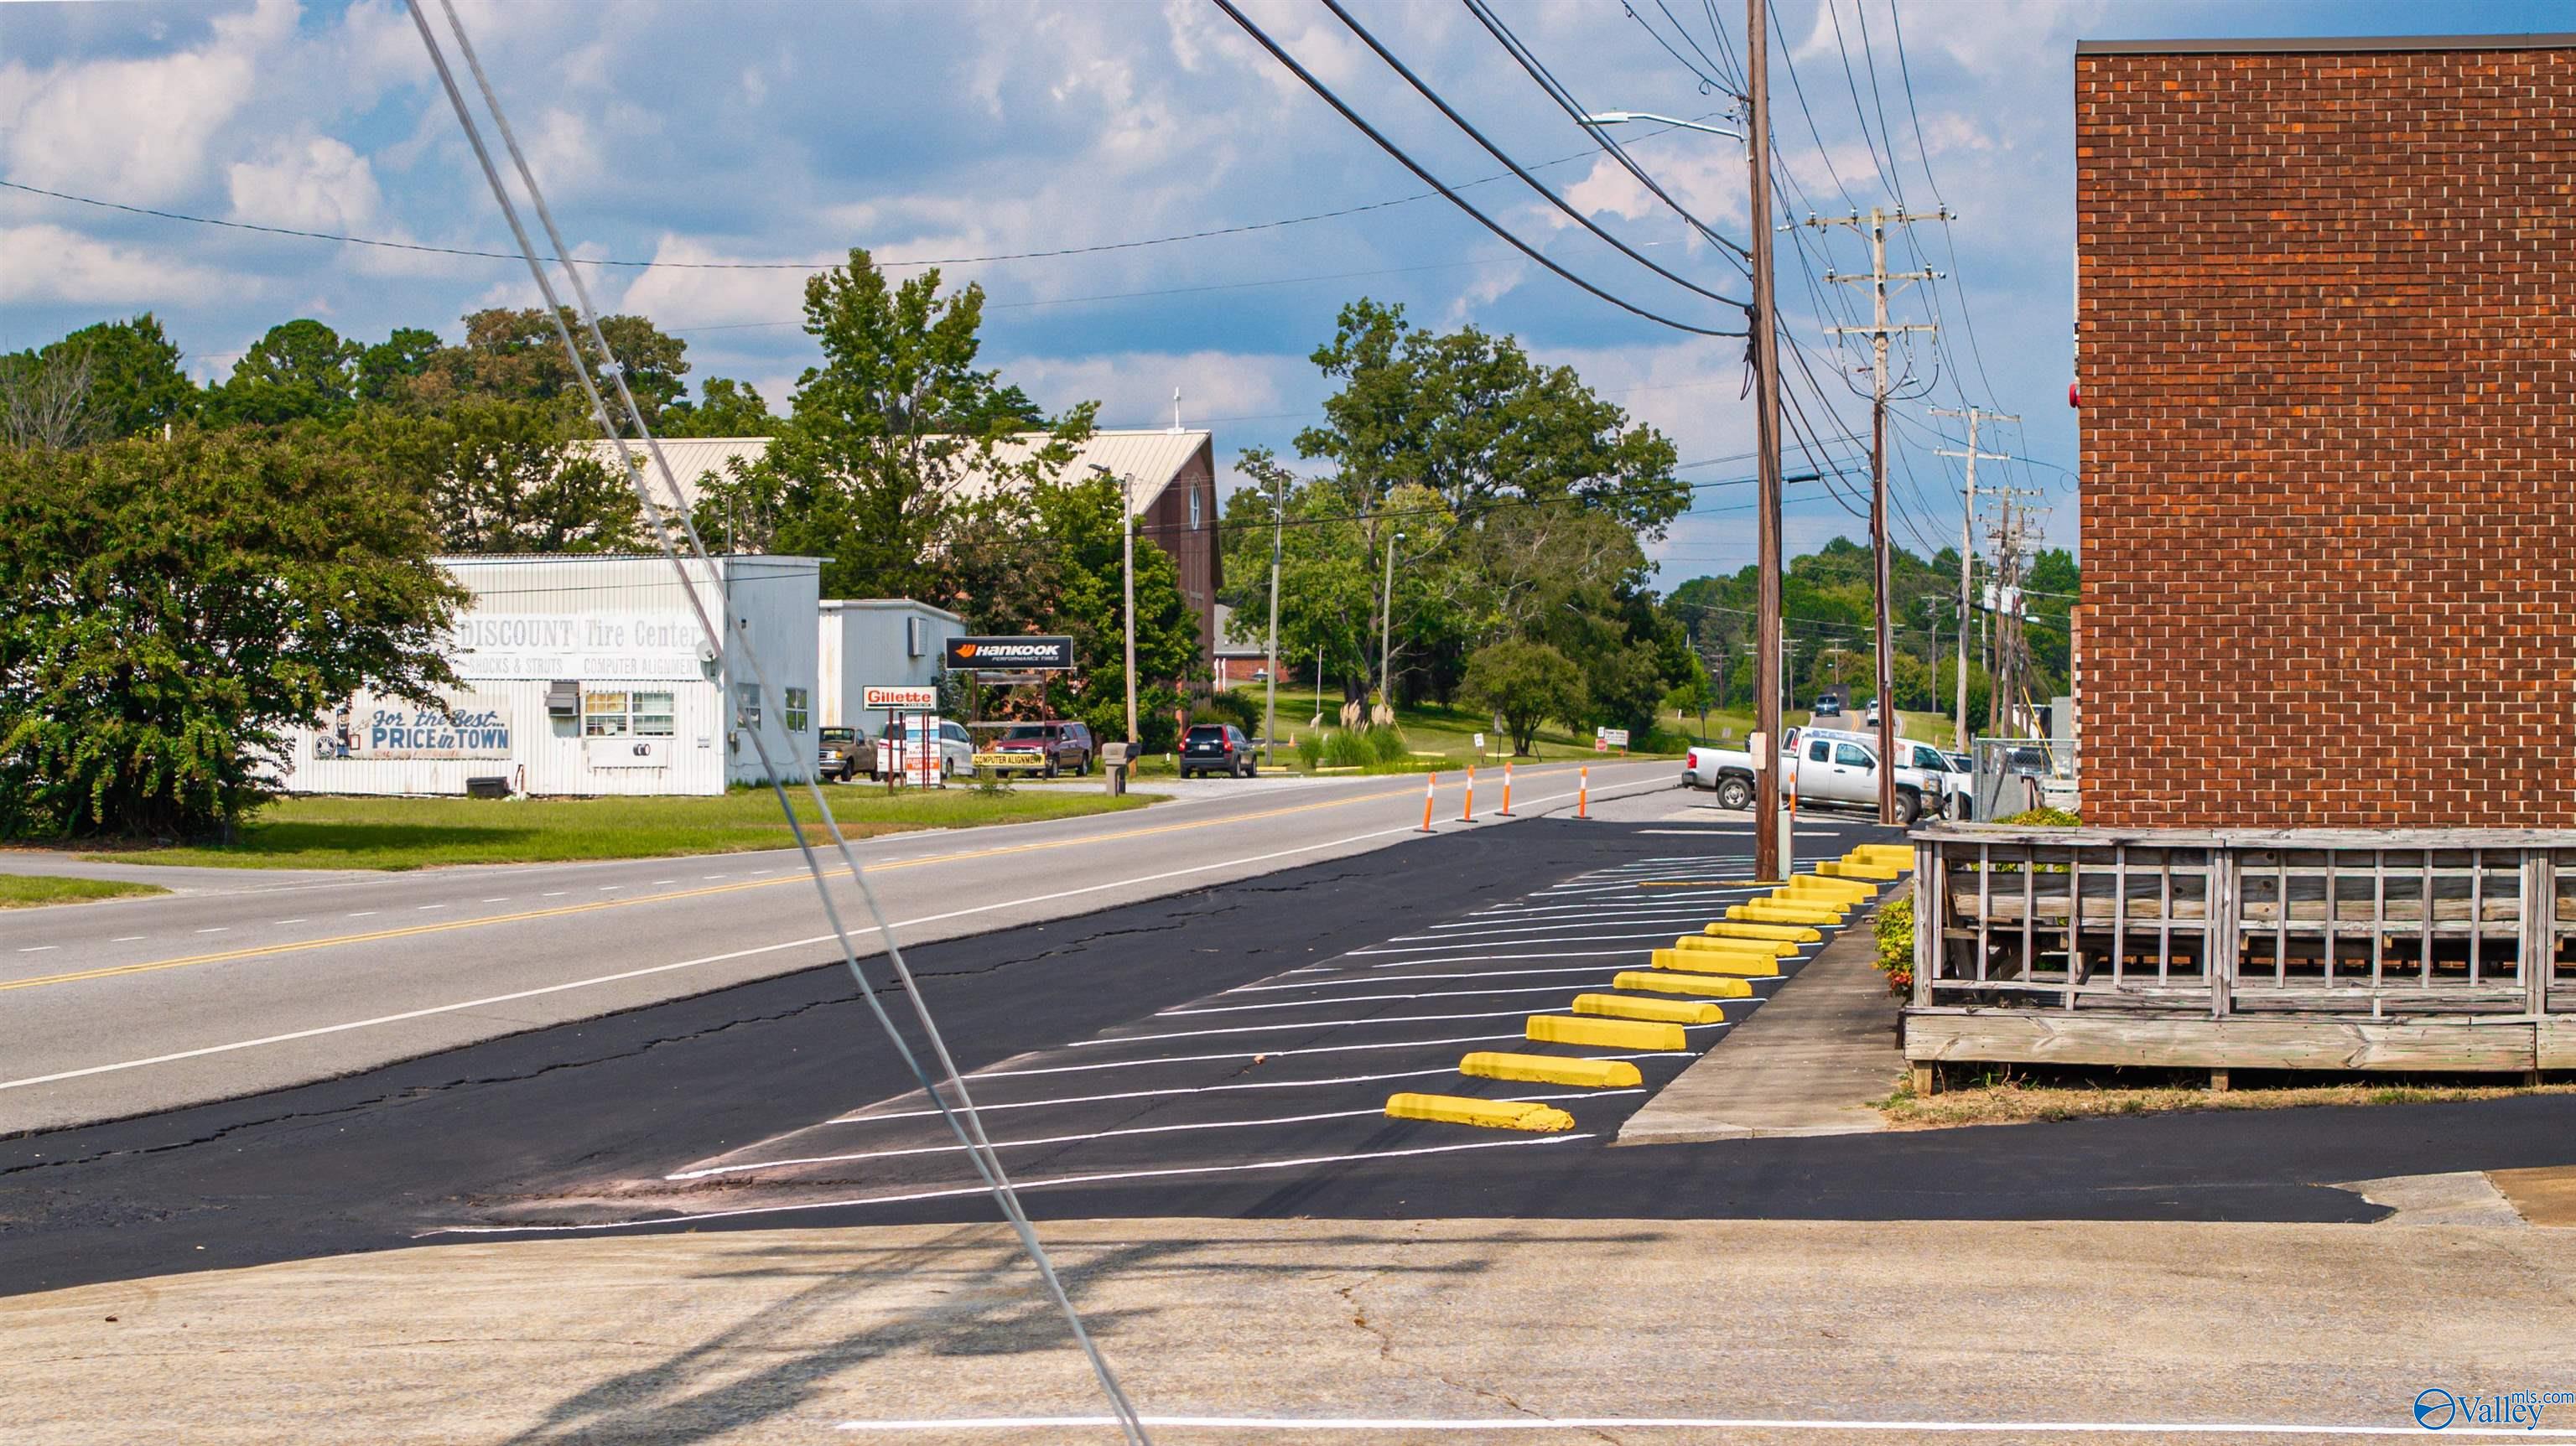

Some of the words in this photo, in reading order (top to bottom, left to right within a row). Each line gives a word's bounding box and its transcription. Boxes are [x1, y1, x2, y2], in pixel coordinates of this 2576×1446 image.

[461, 619, 573, 647] DISCOUNT
[585, 619, 625, 647] Tire
[635, 619, 699, 647] Center
[469, 658, 510, 674] SHOCKS
[513, 658, 522, 674] &
[526, 658, 564, 674] STRUTS
[584, 658, 637, 674] COMPUTER
[641, 658, 699, 675] ALIGNMENT
[868, 690, 932, 702] Gillette
[372, 710, 406, 728] For
[413, 709, 449, 728] the
[371, 728, 437, 749] PRICE
[437, 728, 455, 749] in
[454, 728, 509, 749] TOWN
[974, 755, 1006, 764] COMPUTER
